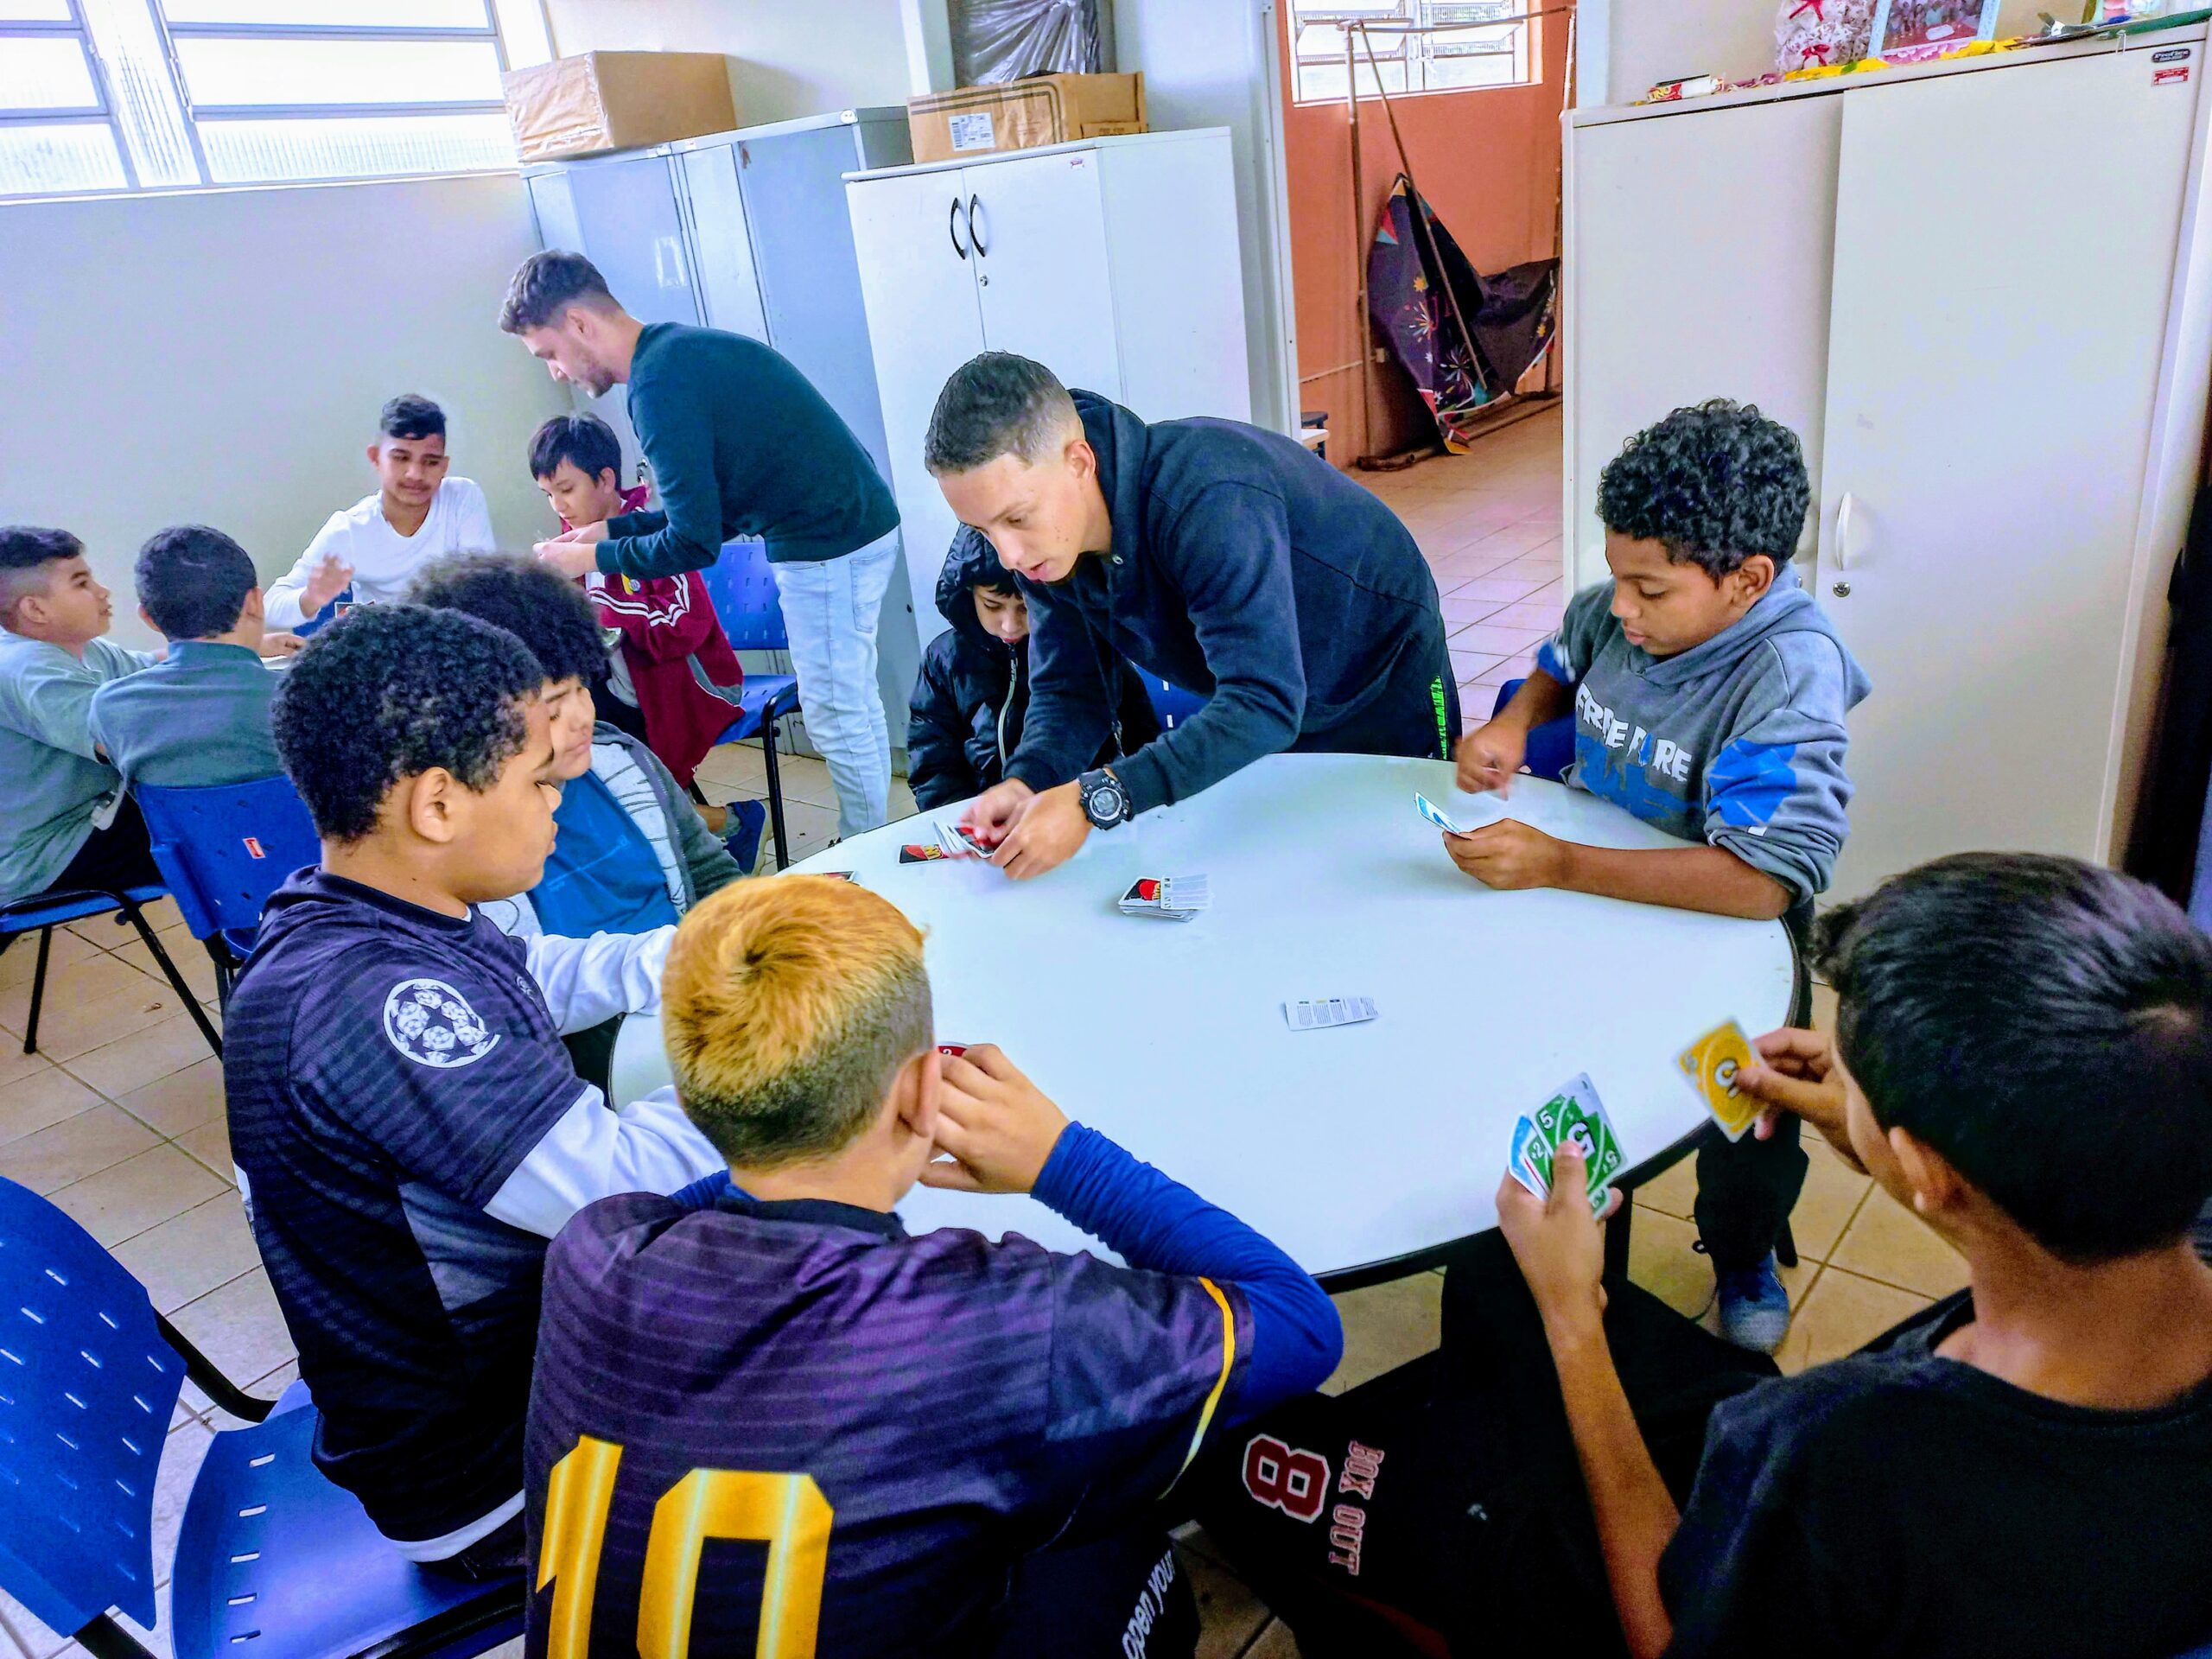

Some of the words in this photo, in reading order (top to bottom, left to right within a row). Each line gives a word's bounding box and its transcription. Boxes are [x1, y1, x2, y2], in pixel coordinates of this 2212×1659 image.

[1538, 1109, 1554, 1131] 5
[1242, 1433, 1332, 1524] 8
[1338, 1440, 1385, 1500] BOX
[535, 1433, 835, 1659] 10
[1328, 1503, 1366, 1576] OUT
[1122, 1590, 1156, 1659] open
